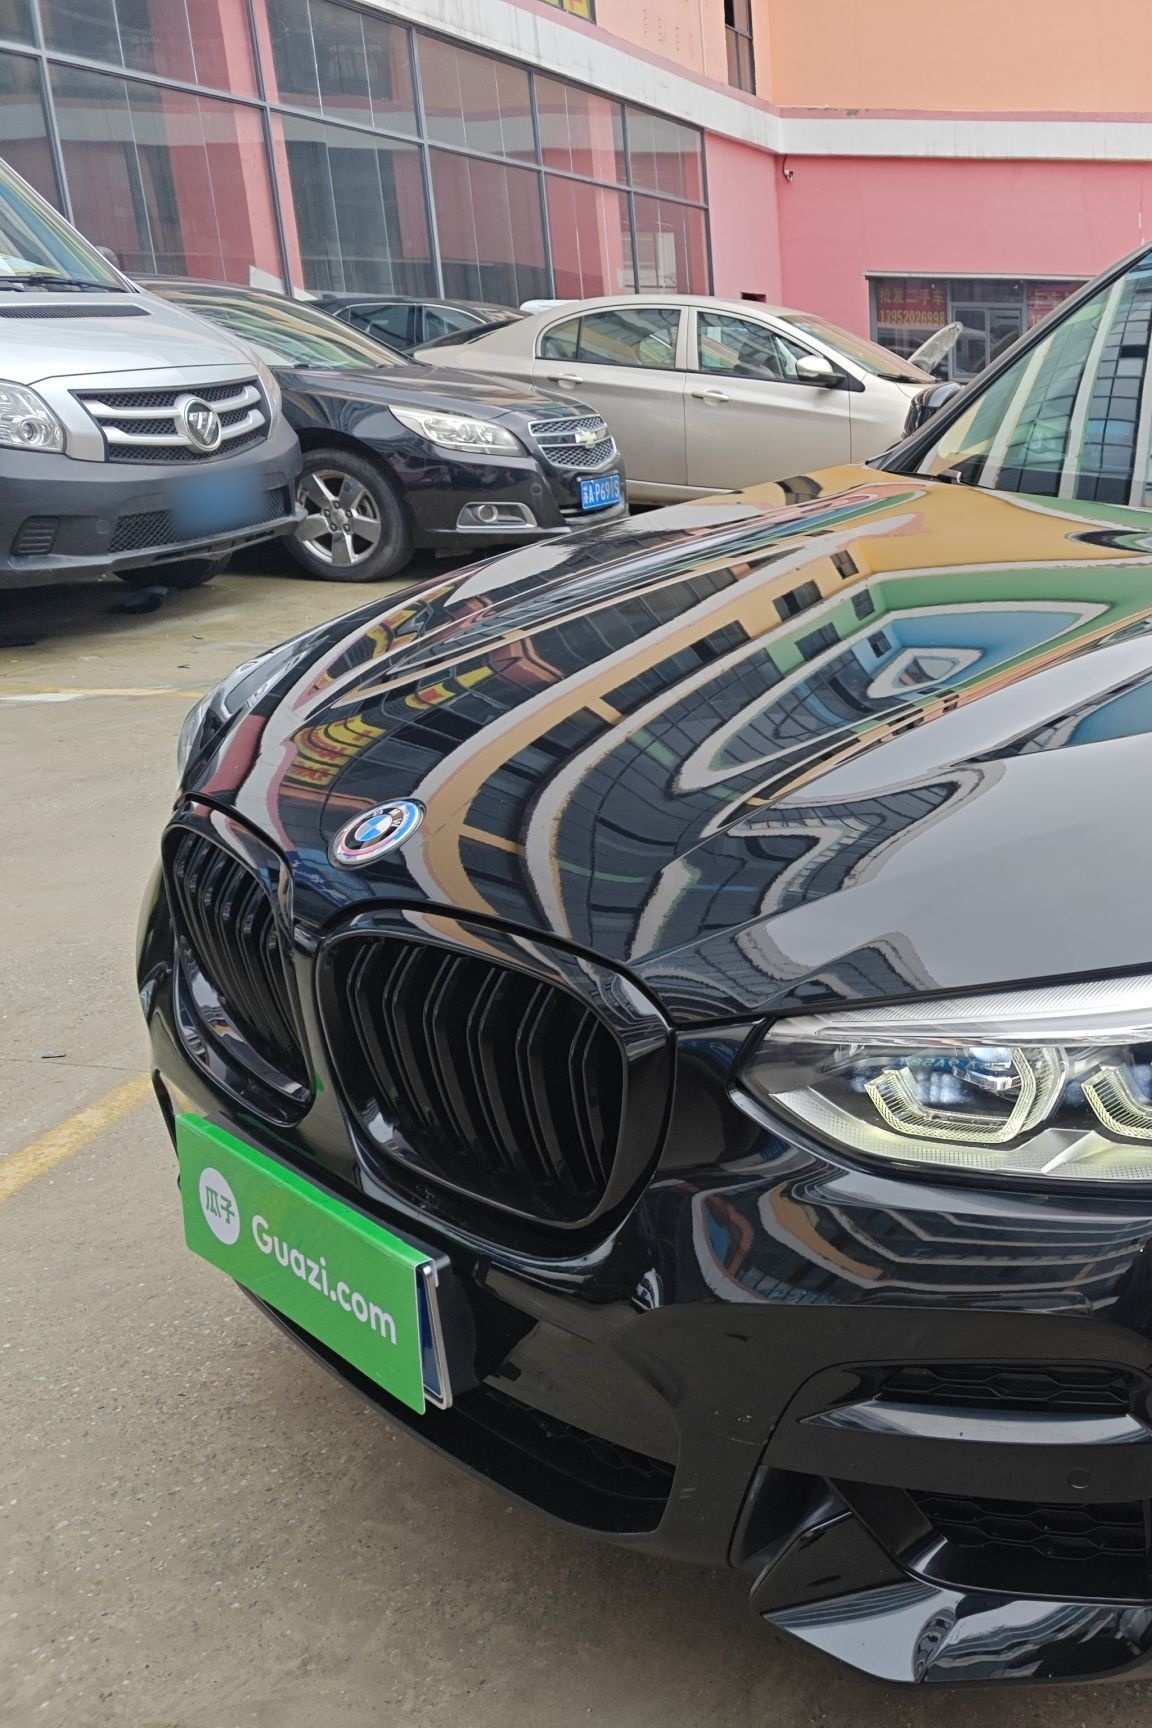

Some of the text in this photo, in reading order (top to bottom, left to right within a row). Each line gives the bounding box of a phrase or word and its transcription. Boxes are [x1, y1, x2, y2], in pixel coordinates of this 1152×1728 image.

[879, 287, 944, 306] 批发二手车
[879, 309, 945, 327] 13952026998
[205, 1185, 235, 1225] 瓜子
[251, 1214, 397, 1345] Guazi.com
